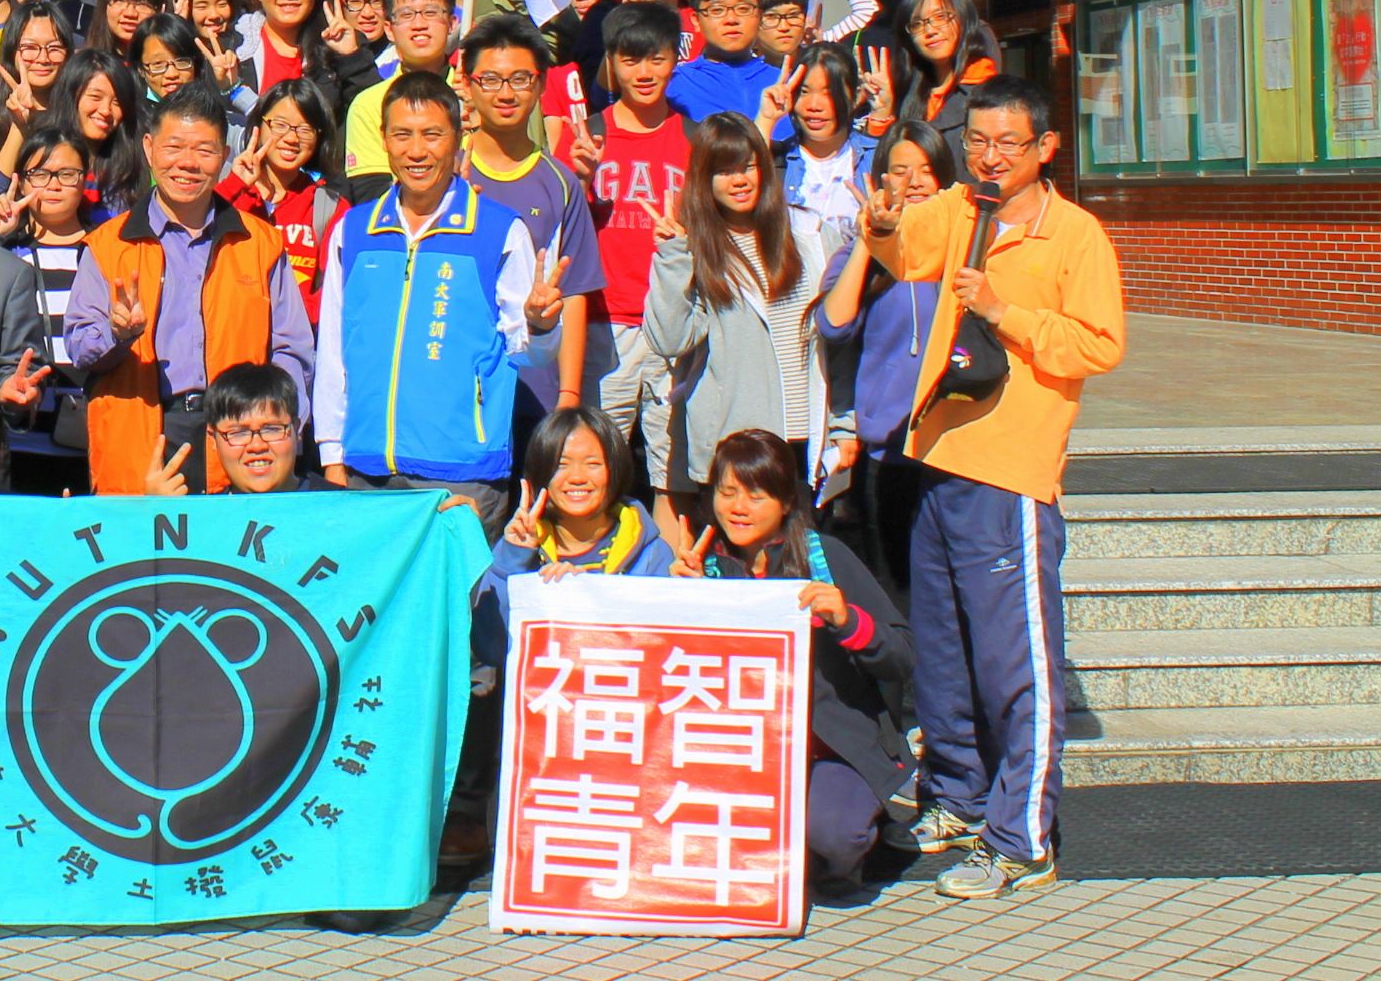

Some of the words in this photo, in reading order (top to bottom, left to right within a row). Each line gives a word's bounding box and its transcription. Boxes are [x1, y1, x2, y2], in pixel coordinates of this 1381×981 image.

[275, 223, 315, 247] VE
[427, 261, 456, 361] 南大軍訓室
[527, 641, 778, 773] 福智
[523, 774, 776, 907] 青年
